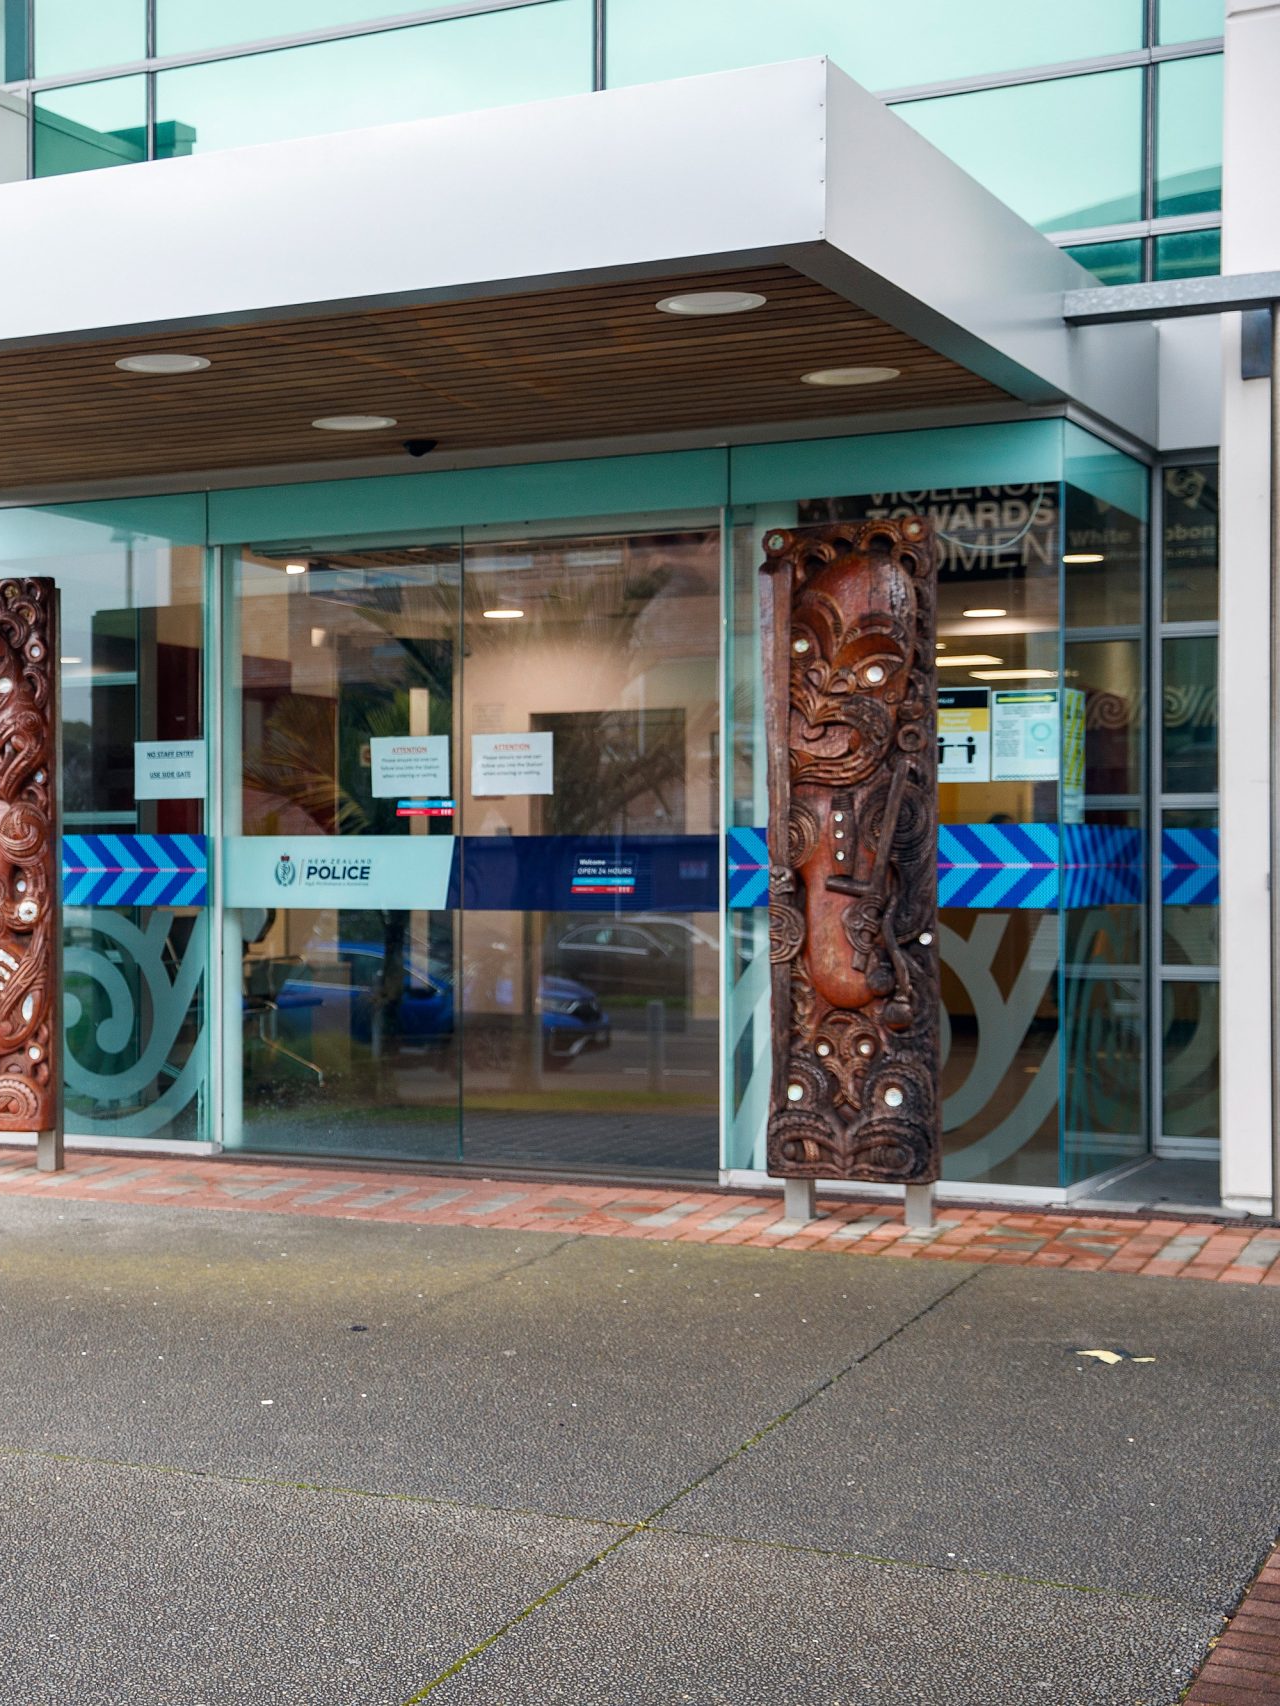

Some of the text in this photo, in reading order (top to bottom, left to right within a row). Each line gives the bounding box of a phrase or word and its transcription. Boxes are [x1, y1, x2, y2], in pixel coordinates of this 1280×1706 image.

[935, 527, 1055, 572] MEN
[392, 746, 428, 754] ATTENTION
[493, 743, 530, 751] ATTENTION
[306, 866, 371, 880] POLICE
[577, 867, 597, 875] OPEN
[607, 867, 632, 875] HOURS
